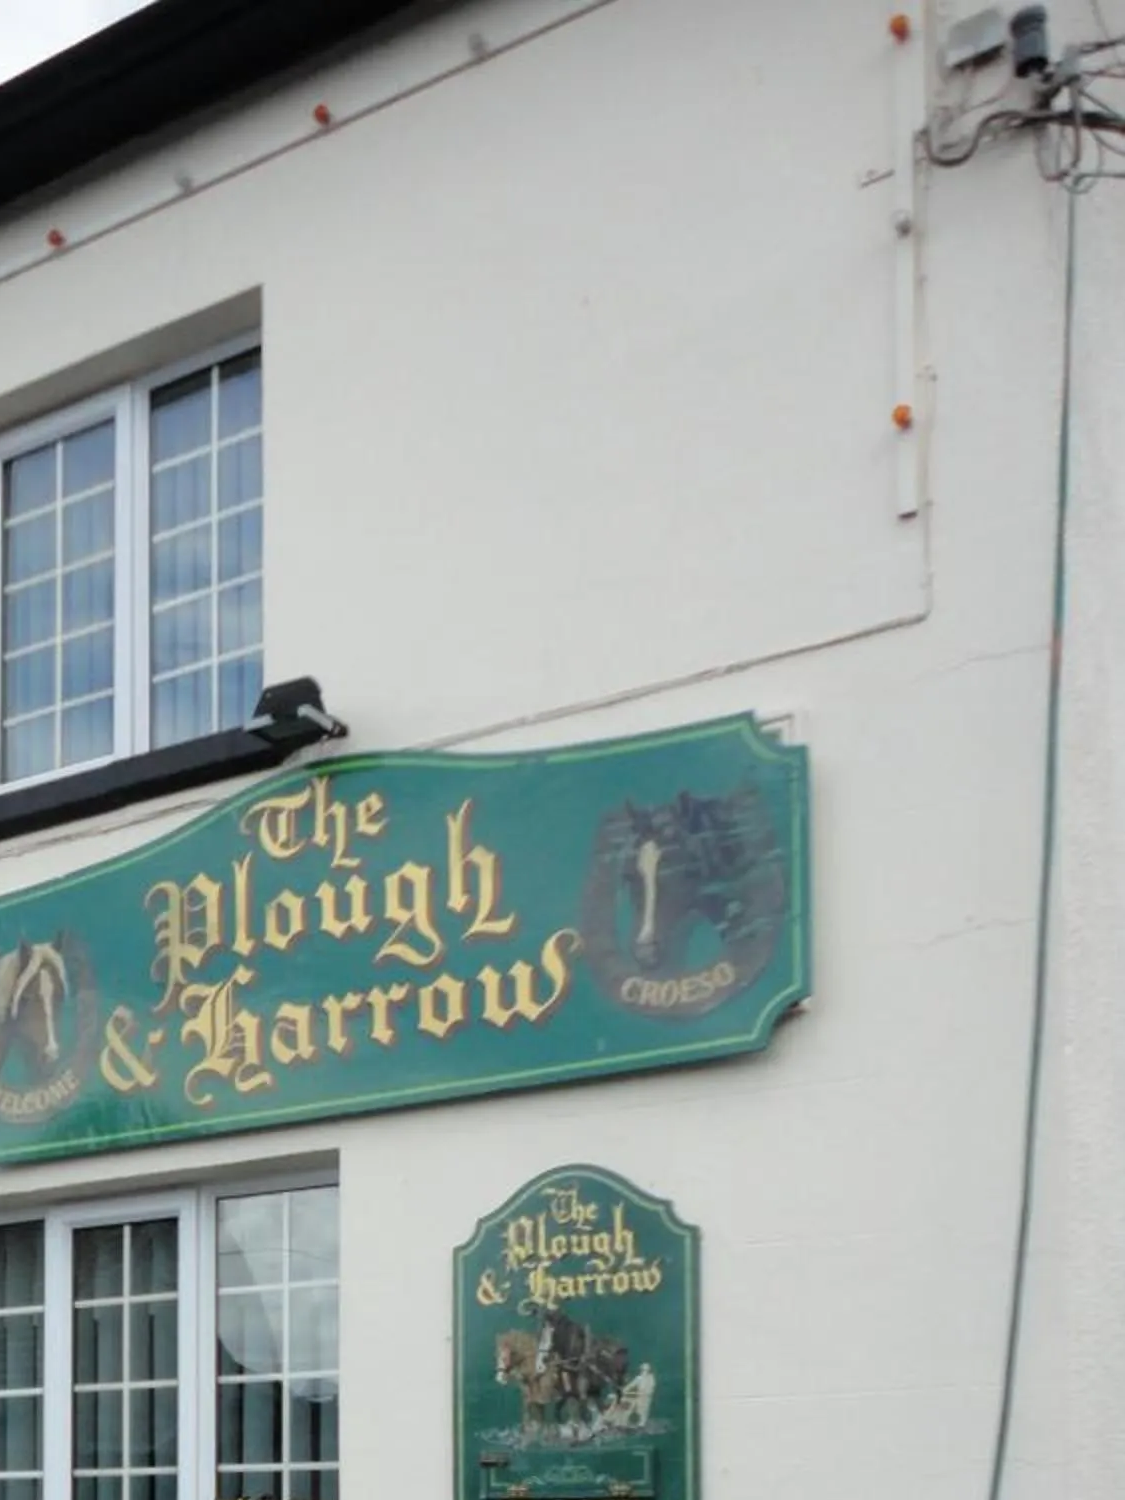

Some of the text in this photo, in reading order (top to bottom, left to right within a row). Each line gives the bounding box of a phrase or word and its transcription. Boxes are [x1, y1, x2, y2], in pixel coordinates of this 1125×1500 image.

[241, 776, 389, 868] The
[145, 799, 516, 1012] Plough
[100, 929, 581, 1106] & Harrow
[621, 961, 735, 1008] CROESO
[501, 1202, 644, 1275] Plough
[541, 1180, 598, 1231] The
[477, 1257, 662, 1316] & Harrow
